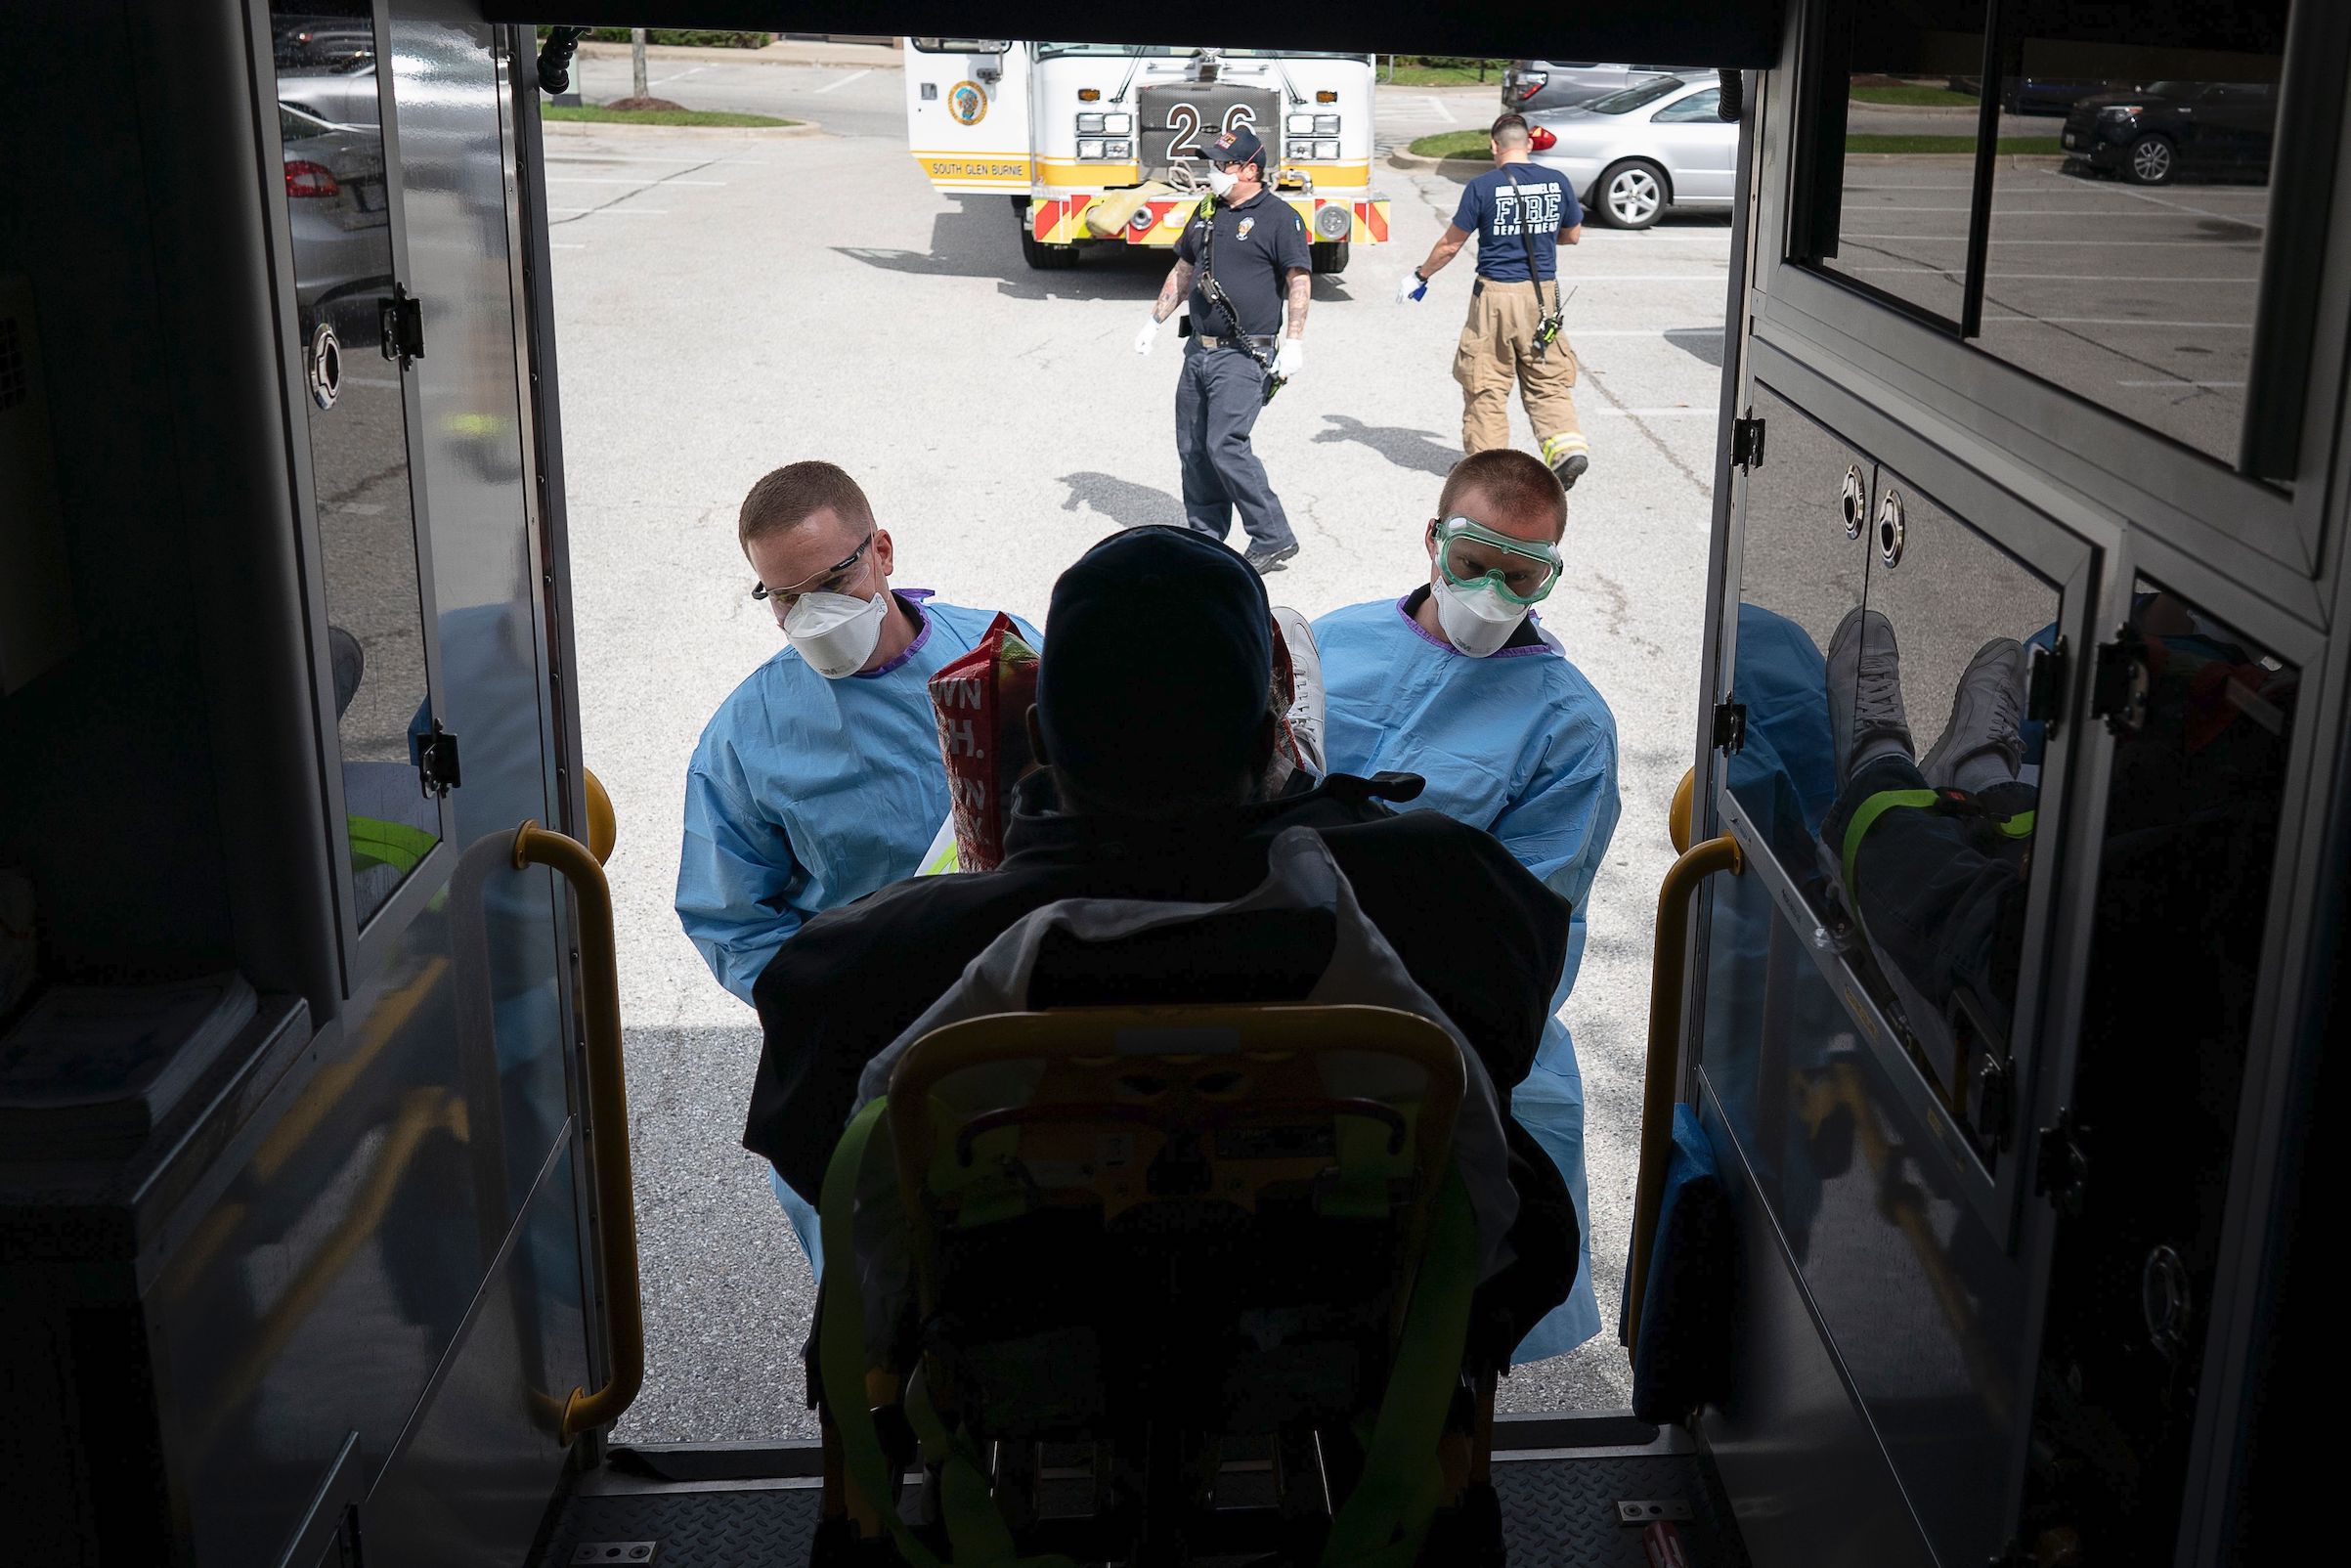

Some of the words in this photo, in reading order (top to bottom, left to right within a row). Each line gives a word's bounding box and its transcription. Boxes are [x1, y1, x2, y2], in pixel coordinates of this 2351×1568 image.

[933, 162, 962, 175] SOUTH
[965, 163, 988, 176] GLEN
[991, 164, 1023, 177] BURNIE
[1494, 194, 1561, 225] FIRE
[1493, 221, 1559, 236] DEPATMENT
